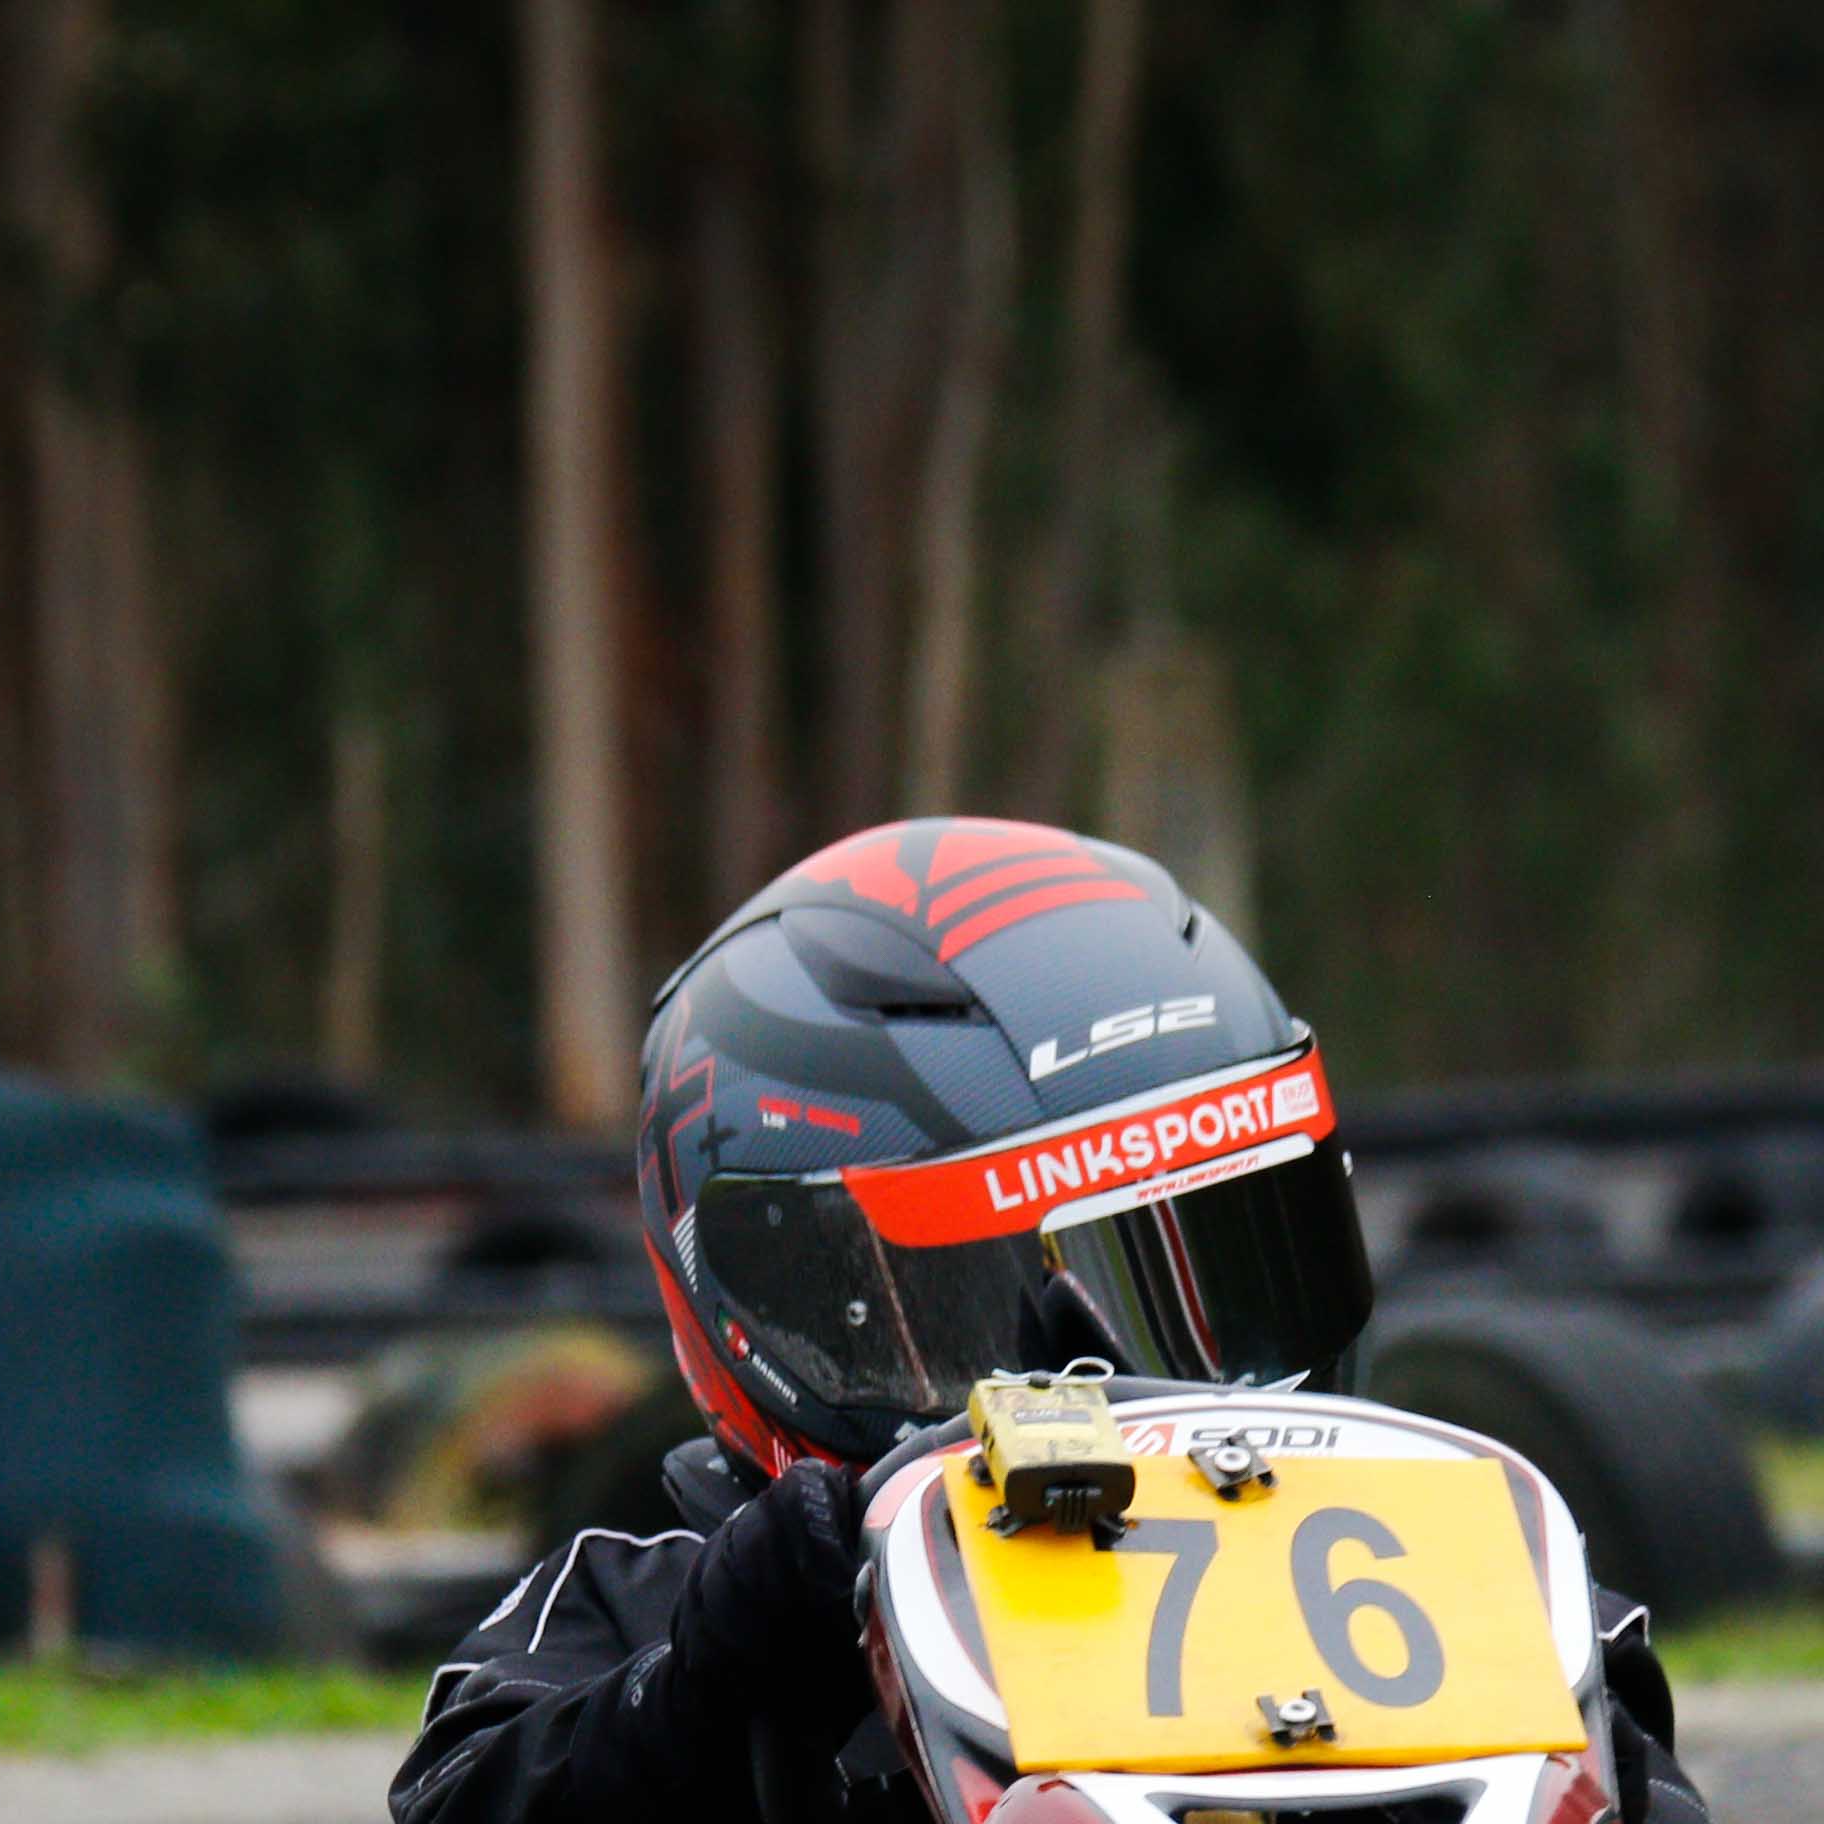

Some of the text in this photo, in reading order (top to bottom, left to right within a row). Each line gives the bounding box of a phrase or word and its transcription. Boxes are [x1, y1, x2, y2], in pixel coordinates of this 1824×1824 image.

[1029, 994, 1217, 1082] LS2
[984, 1083, 1269, 1212] LINKSPORT
[1093, 1506, 1445, 1719] 76
